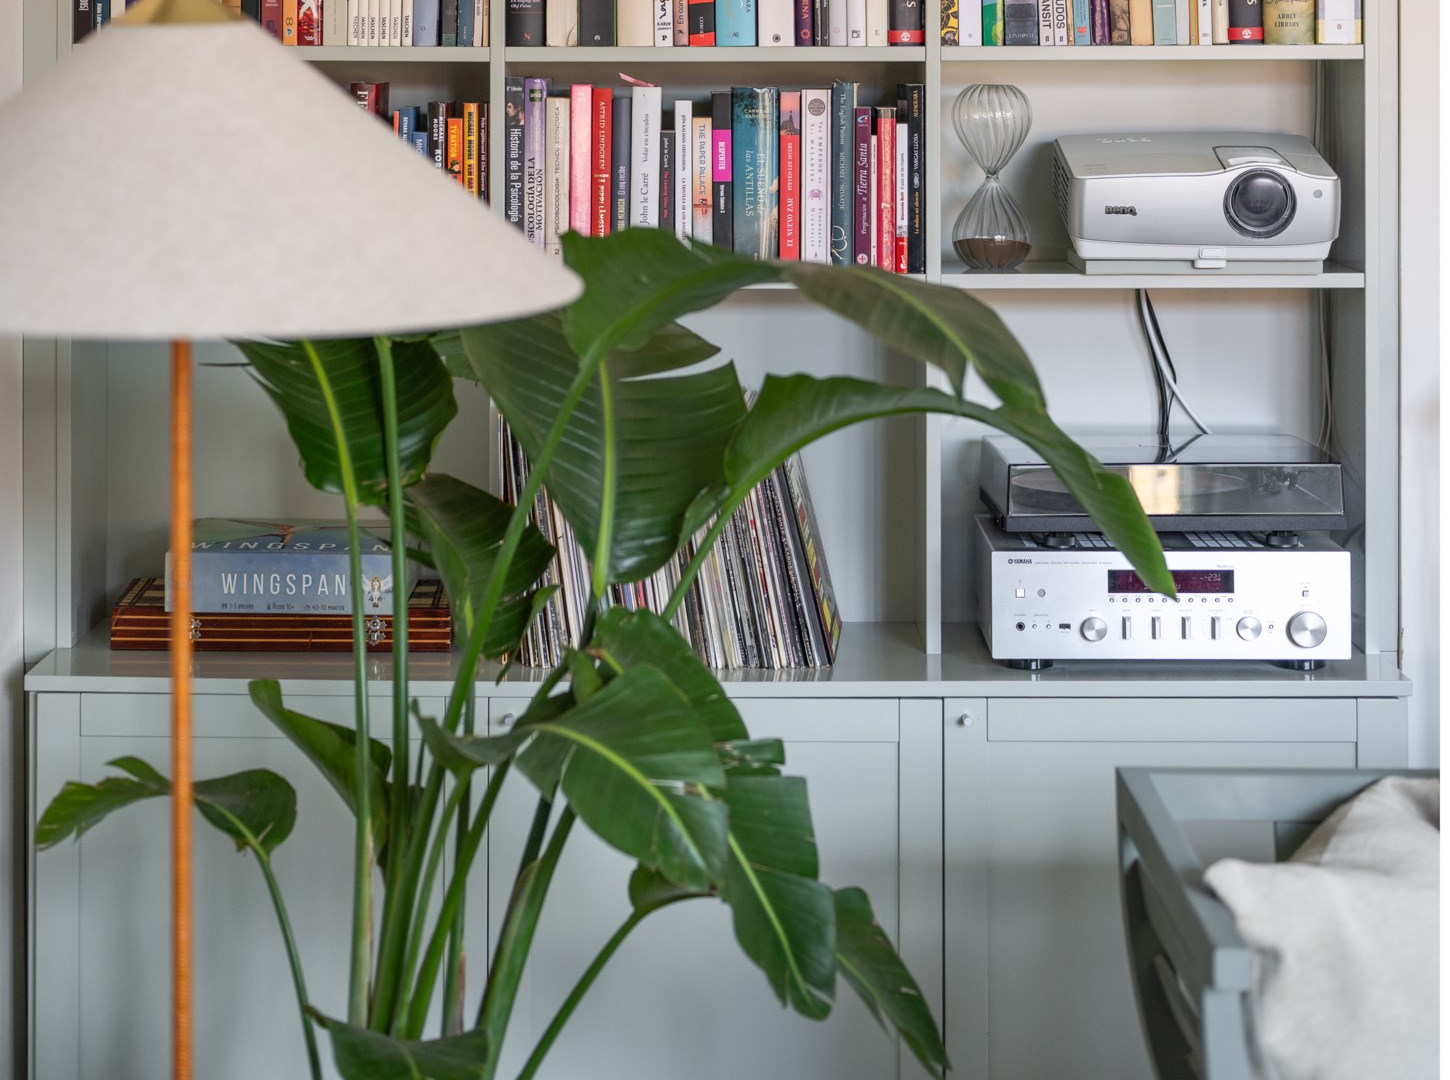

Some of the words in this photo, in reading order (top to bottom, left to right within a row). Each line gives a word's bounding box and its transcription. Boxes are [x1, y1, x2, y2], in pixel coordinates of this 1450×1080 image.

[510, 128, 520, 158] Historia
[511, 161, 521, 170] de
[509, 183, 521, 222] Psicología
[1104, 205, 1137, 216] BenQ
[221, 573, 346, 595] WINGSPAN
